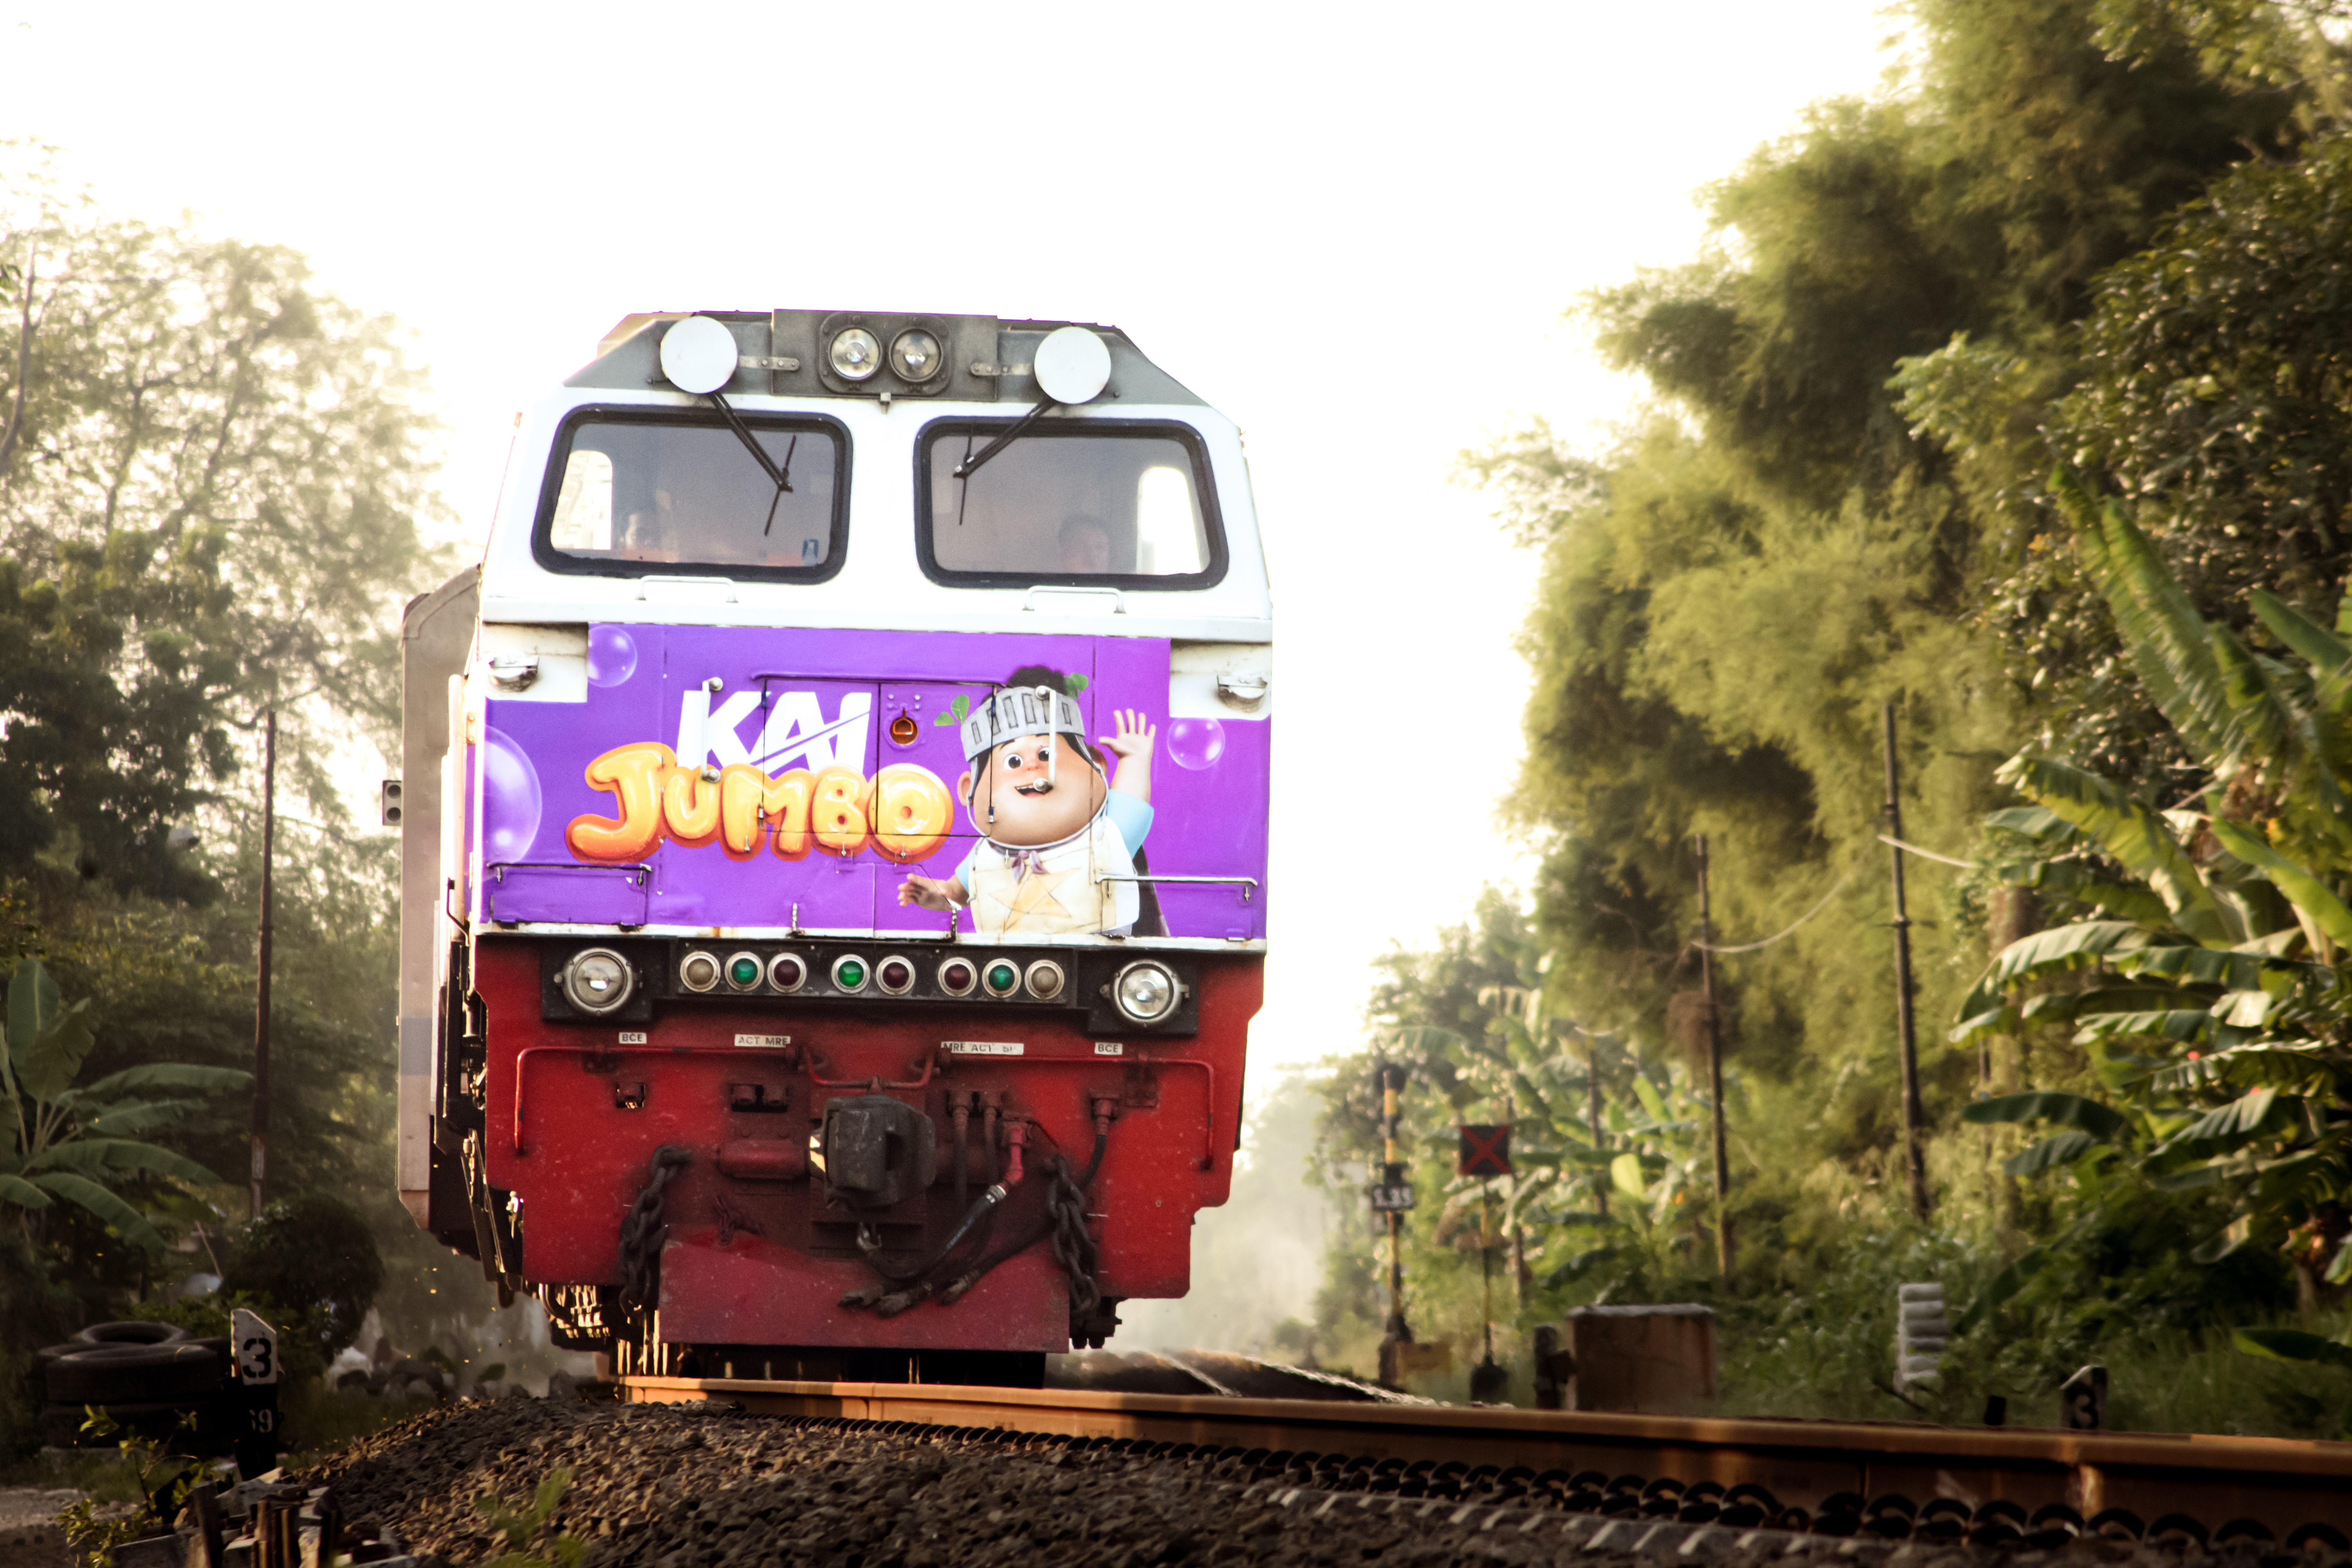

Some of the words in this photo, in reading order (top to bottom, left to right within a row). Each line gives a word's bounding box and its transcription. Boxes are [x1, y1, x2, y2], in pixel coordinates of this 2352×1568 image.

[676, 690, 872, 775] KAI
[566, 742, 953, 862] JUMBO
[622, 1033, 642, 1042] BCE
[739, 1036, 760, 1045] ACT
[1098, 1044, 1118, 1053] BCE
[243, 1338, 271, 1378] 3
